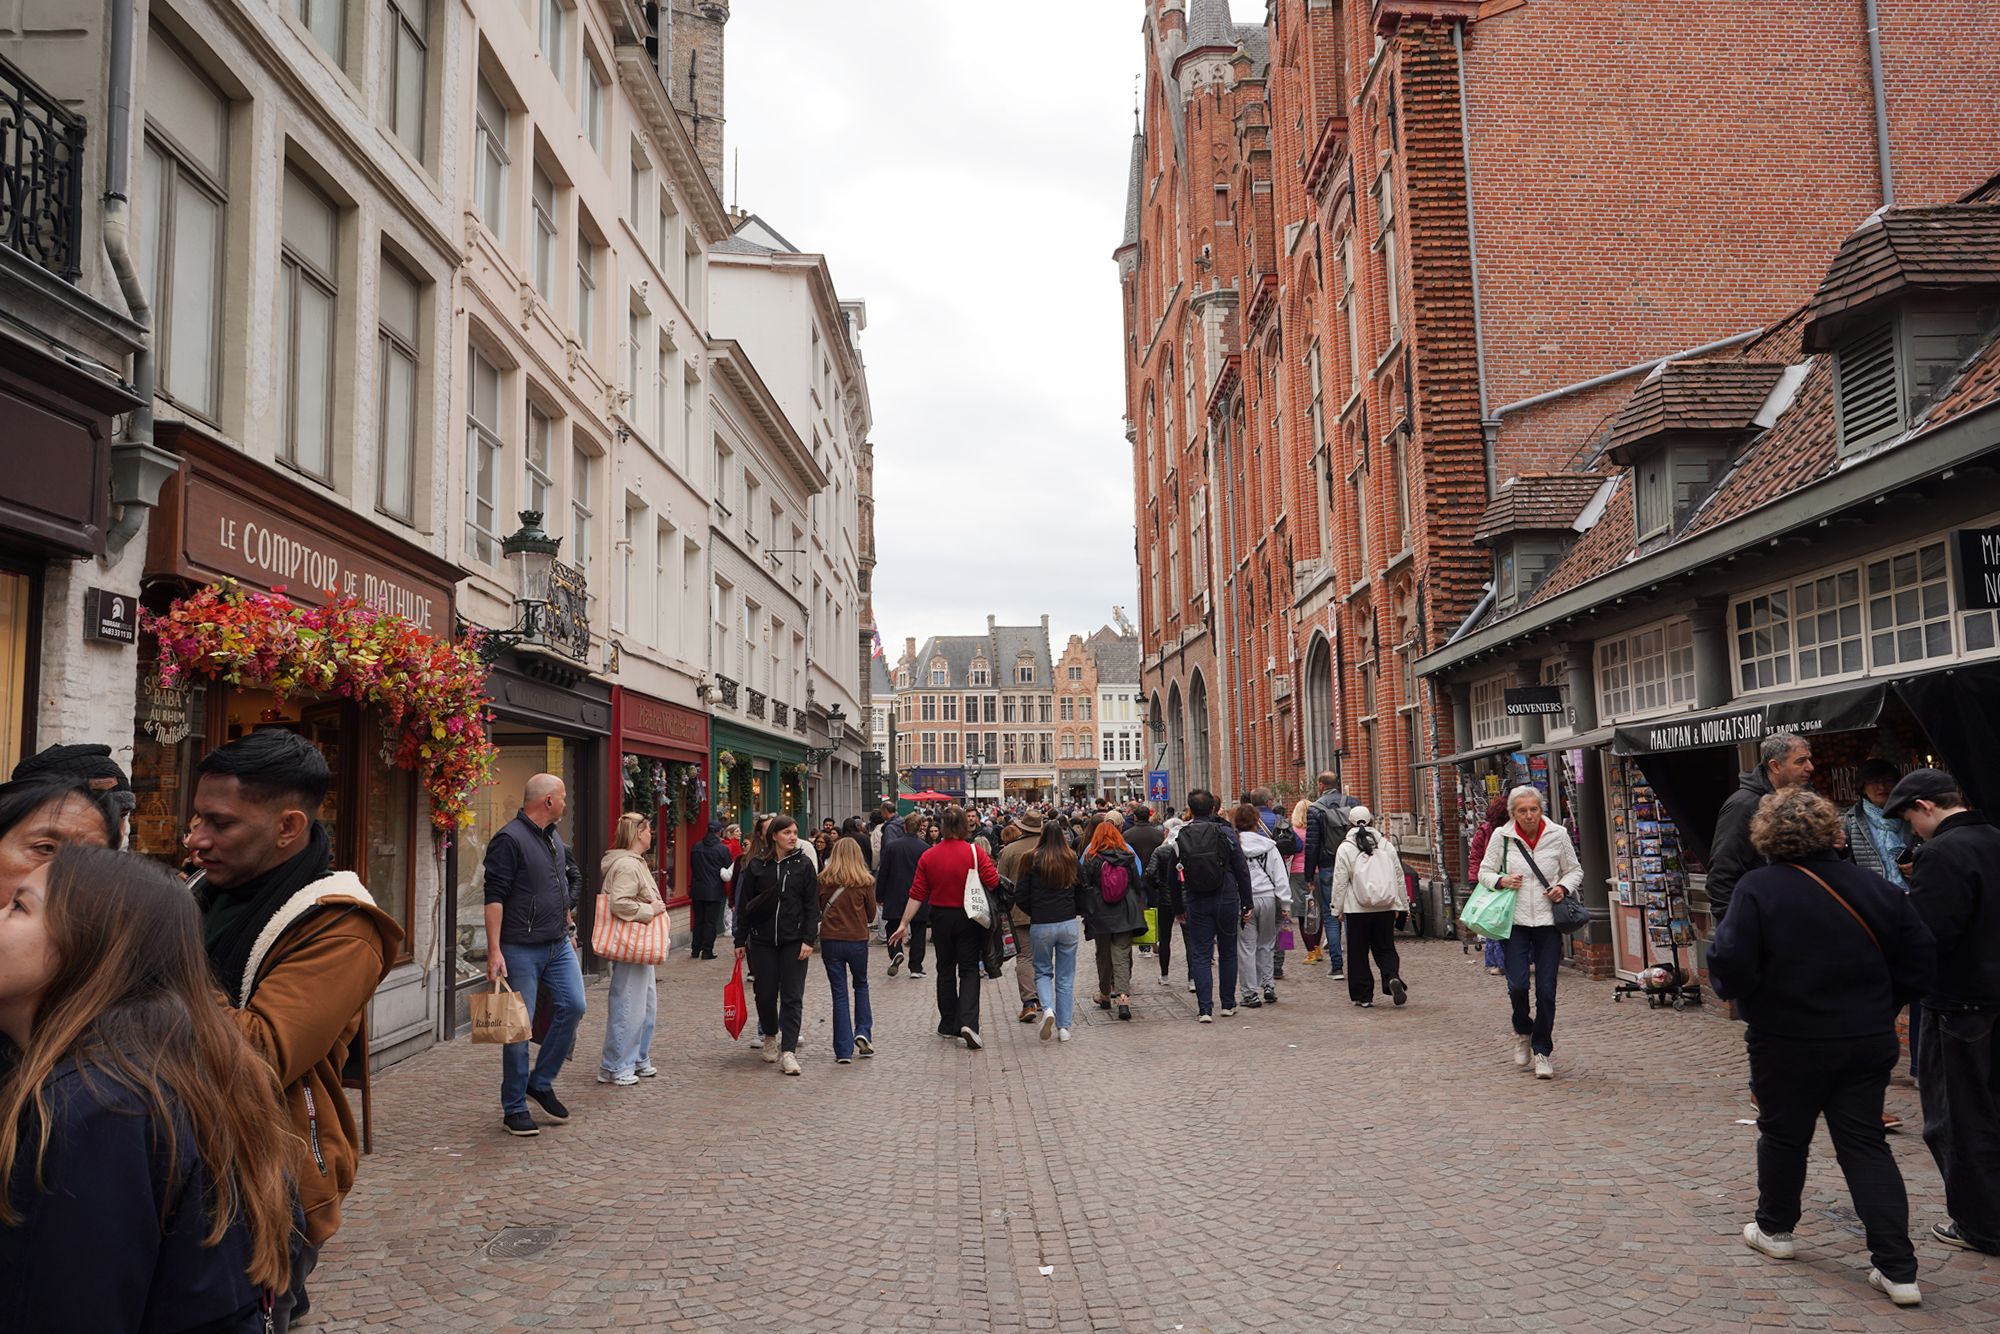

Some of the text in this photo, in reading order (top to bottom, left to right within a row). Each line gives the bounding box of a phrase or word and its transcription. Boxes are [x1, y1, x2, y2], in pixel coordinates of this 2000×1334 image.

[220, 517, 432, 630] LE COMPTOIR DE MATHILDE
[153, 688, 182, 708] BABA
[1507, 702, 1562, 714] SOUVENIERS
[150, 708, 186, 723] AU RHUM
[154, 721, 191, 748] Mathilde
[1650, 725, 1692, 751] MARZIPAN
[1693, 728, 1699, 744] &
[1700, 713, 1763, 744] NOUGATSHOP
[1776, 722, 1799, 734] BROWN
[1800, 719, 1823, 731] SUGAR
